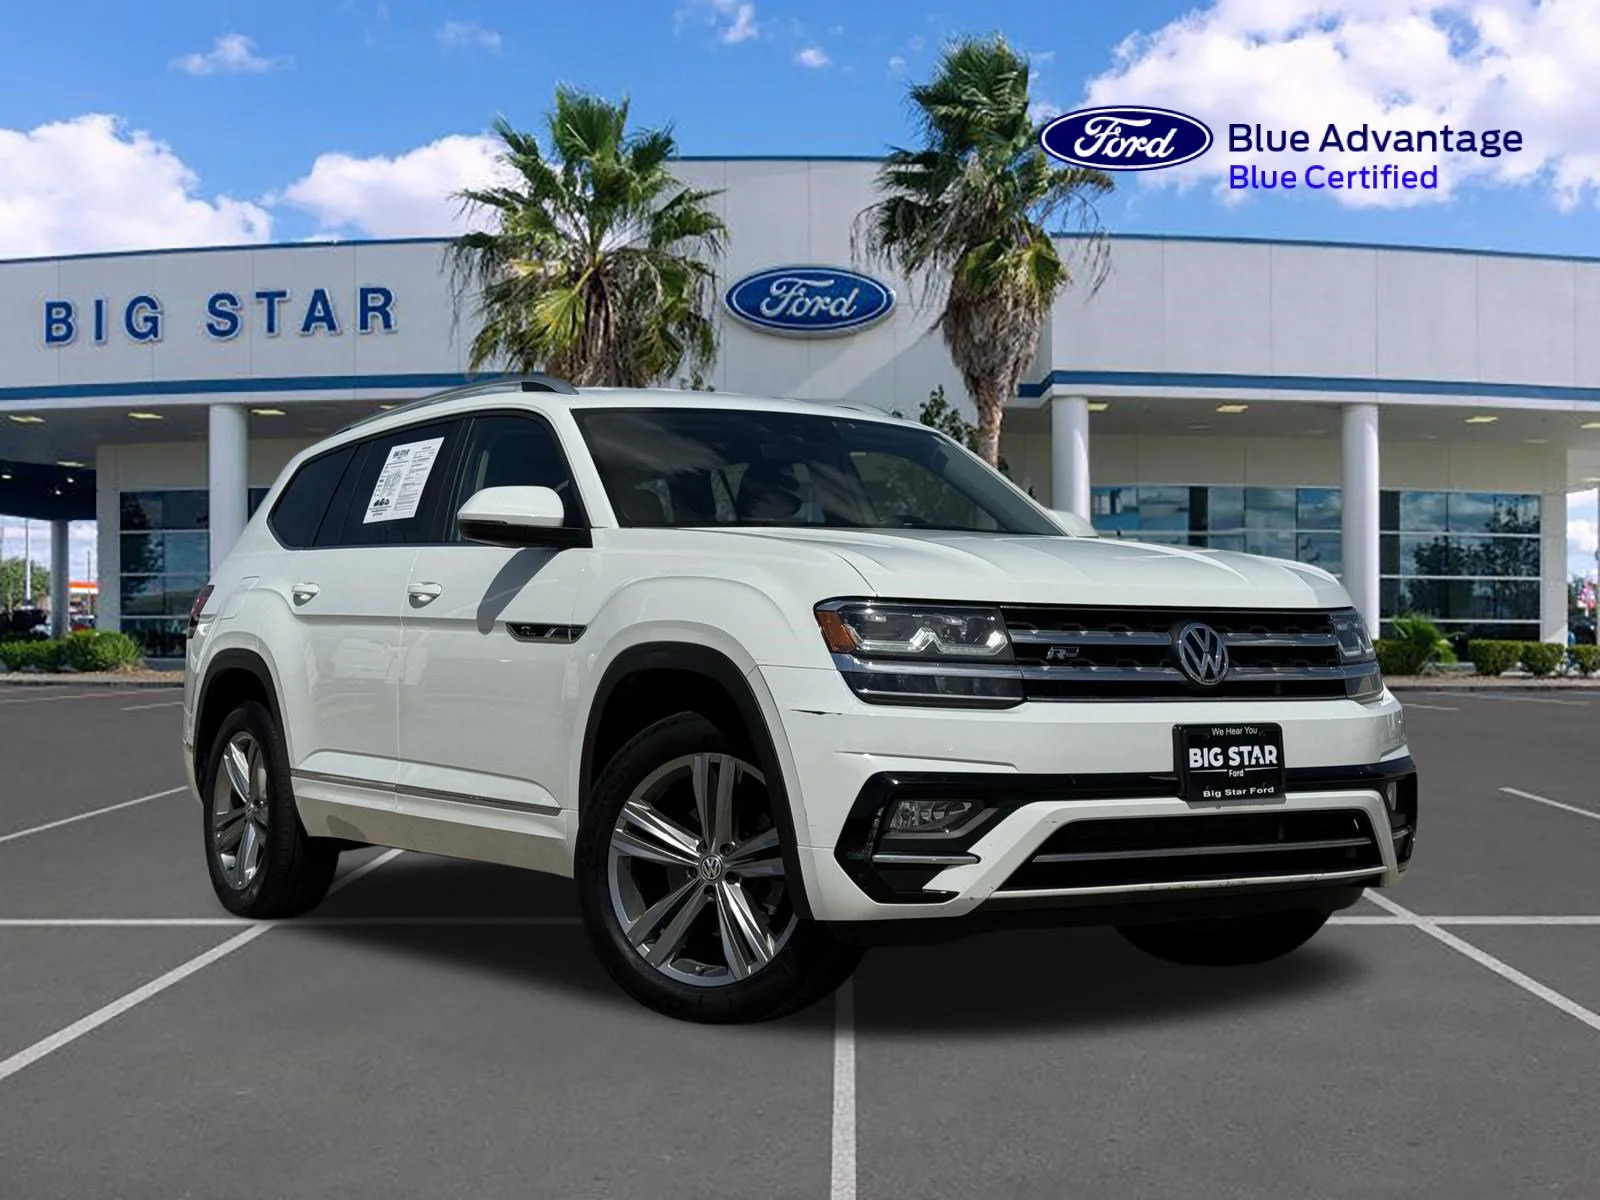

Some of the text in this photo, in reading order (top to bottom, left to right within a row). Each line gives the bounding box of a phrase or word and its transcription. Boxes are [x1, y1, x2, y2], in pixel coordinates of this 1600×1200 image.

[760, 277, 860, 318] Ford
[45, 286, 397, 347] BIG STAR
[1211, 726, 1258, 736] We Hear You
[1188, 745, 1278, 768] BIG STAR
[1228, 768, 1245, 777] Ford
[1203, 786, 1275, 798] Big Star Ford
